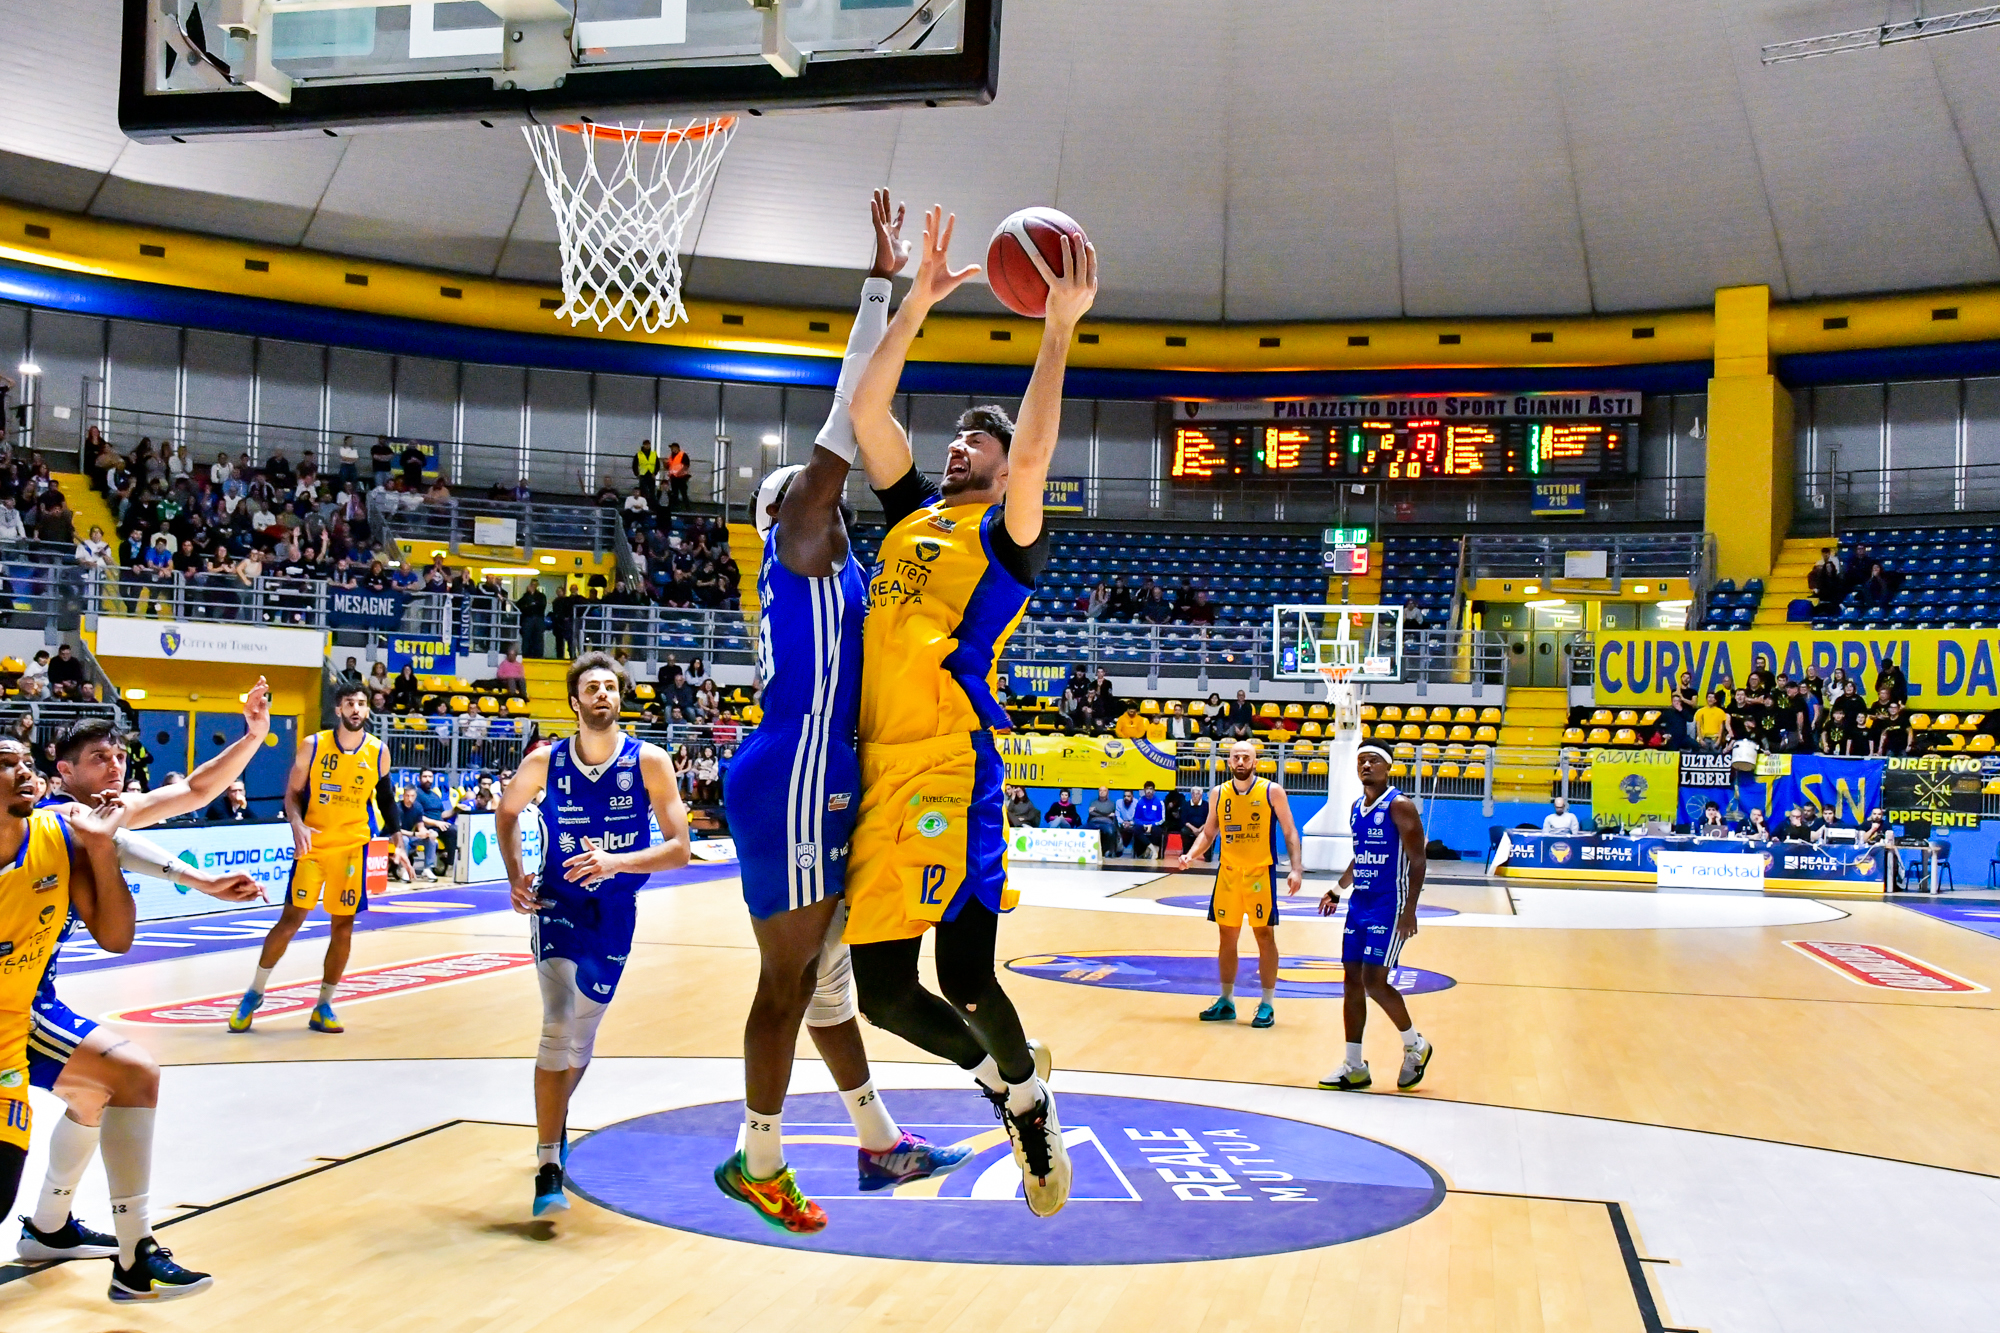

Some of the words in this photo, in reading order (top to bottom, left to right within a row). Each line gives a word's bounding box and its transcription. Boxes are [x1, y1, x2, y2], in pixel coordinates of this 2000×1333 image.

[1274, 402, 1380, 417] PALAZZETTO
[1387, 401, 1437, 416] DELLO
[1445, 398, 1506, 416] SPORT
[1514, 397, 1580, 415] GIANNI
[1588, 396, 1632, 415] ASTI
[1380, 434, 1395, 450] 12
[1416, 434, 1436, 450] 27
[1043, 481, 1079, 492] ETTORE
[1536, 484, 1581, 496] SETTORE
[1549, 495, 1568, 507] 215
[1352, 548, 1367, 573] 5
[334, 593, 395, 616] MESAGNE
[394, 639, 451, 656] SETTORE
[1014, 665, 1066, 680] SETTORE
[1599, 640, 1736, 694] CURVA
[1937, 639, 2000, 697] DA
[1030, 679, 1049, 692] 111
[1003, 738, 1033, 756] ANA
[321, 754, 338, 770] 46
[1681, 754, 1732, 768] ULTRAS
[1888, 757, 1982, 773] DIRETTIVO
[1005, 763, 1045, 782] RINO!
[1681, 772, 1731, 786] LIBERI
[557, 775, 571, 795] 4
[609, 795, 633, 807] a2a
[1225, 798, 1232, 814] 8
[1367, 827, 1384, 837] a2a
[1034, 838, 1087, 849] BONIFICHE
[1509, 845, 1535, 853] EALE
[1596, 846, 1632, 856] REALE
[204, 849, 261, 869] STUDIO
[263, 847, 296, 862] CAS
[1354, 850, 1390, 865] valtur
[1799, 856, 1837, 865] REALE
[1692, 864, 1760, 879] randstad
[920, 864, 946, 905] 12
[340, 889, 356, 907] 46
[1255, 903, 1263, 919] 8
[858, 1090, 875, 1107] 23
[7, 1100, 29, 1132] 10
[750, 1120, 771, 1131] 23
[1123, 1127, 1254, 1202] REALE
[1202, 1128, 1319, 1202] MUTUA
